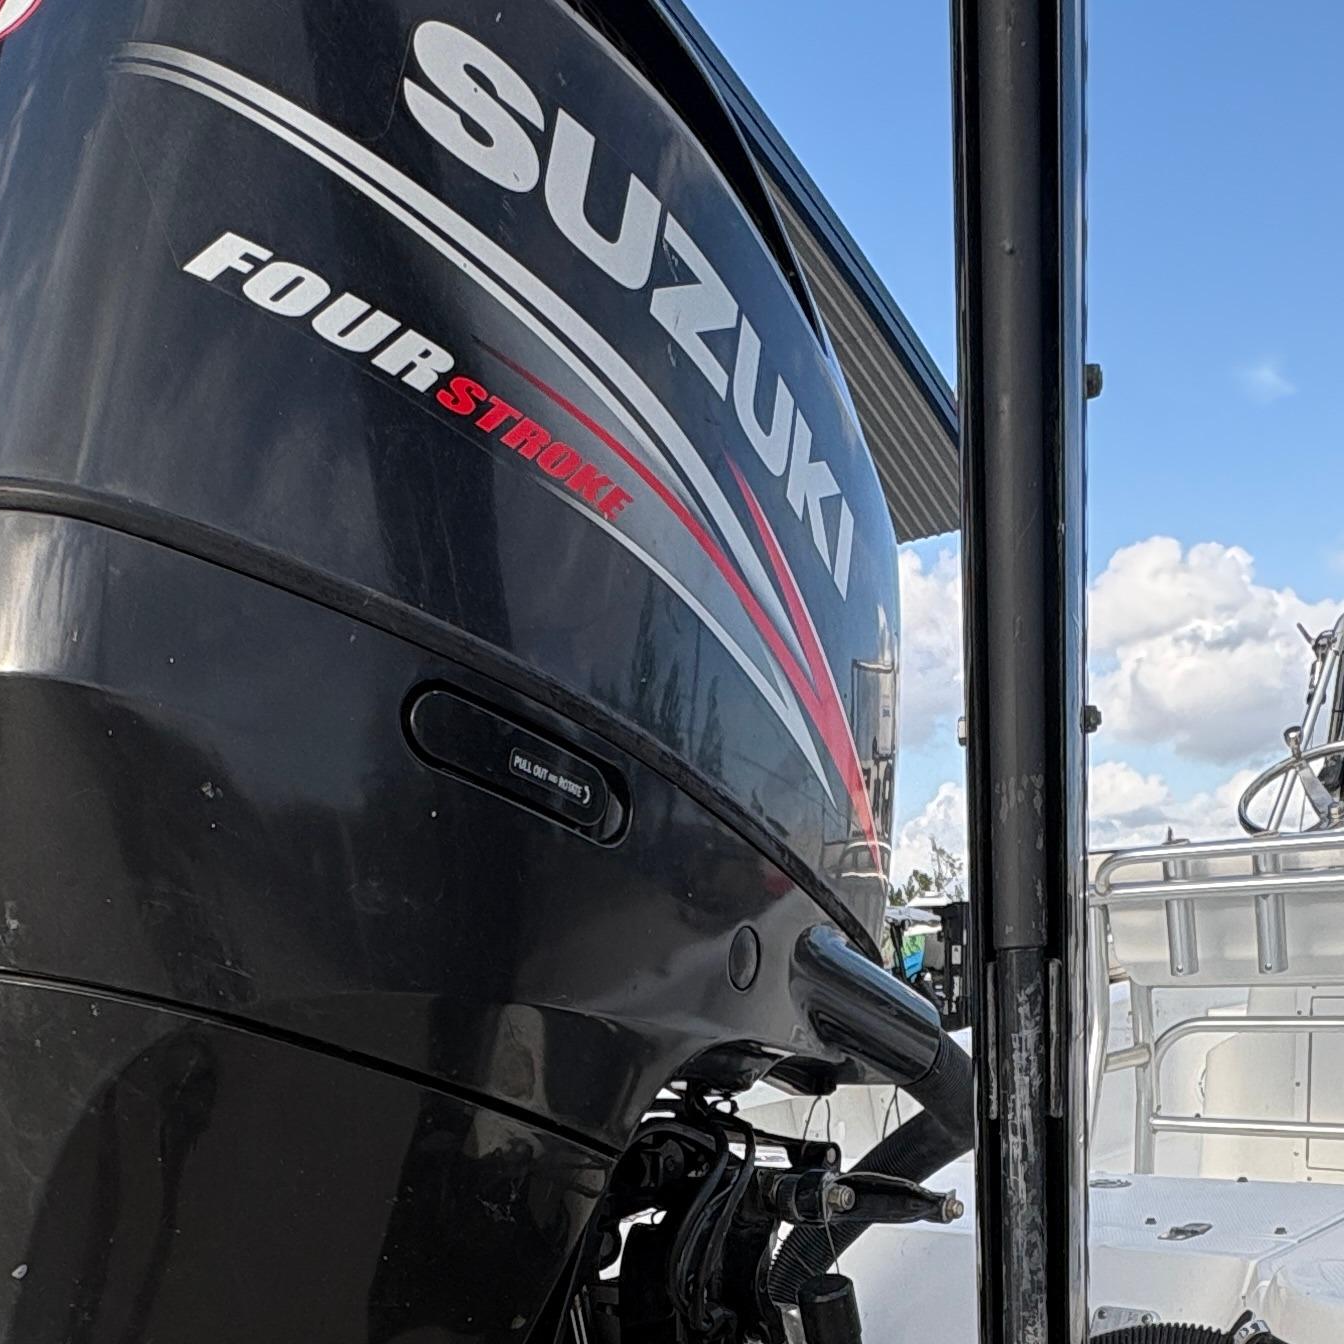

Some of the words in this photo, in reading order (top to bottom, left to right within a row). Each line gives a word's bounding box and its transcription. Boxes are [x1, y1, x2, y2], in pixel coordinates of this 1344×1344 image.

[402, 20, 854, 602] SUZUKI
[513, 755, 533, 775] PULL
[533, 764, 549, 780] OUT
[558, 776, 583, 798] ROTATE
